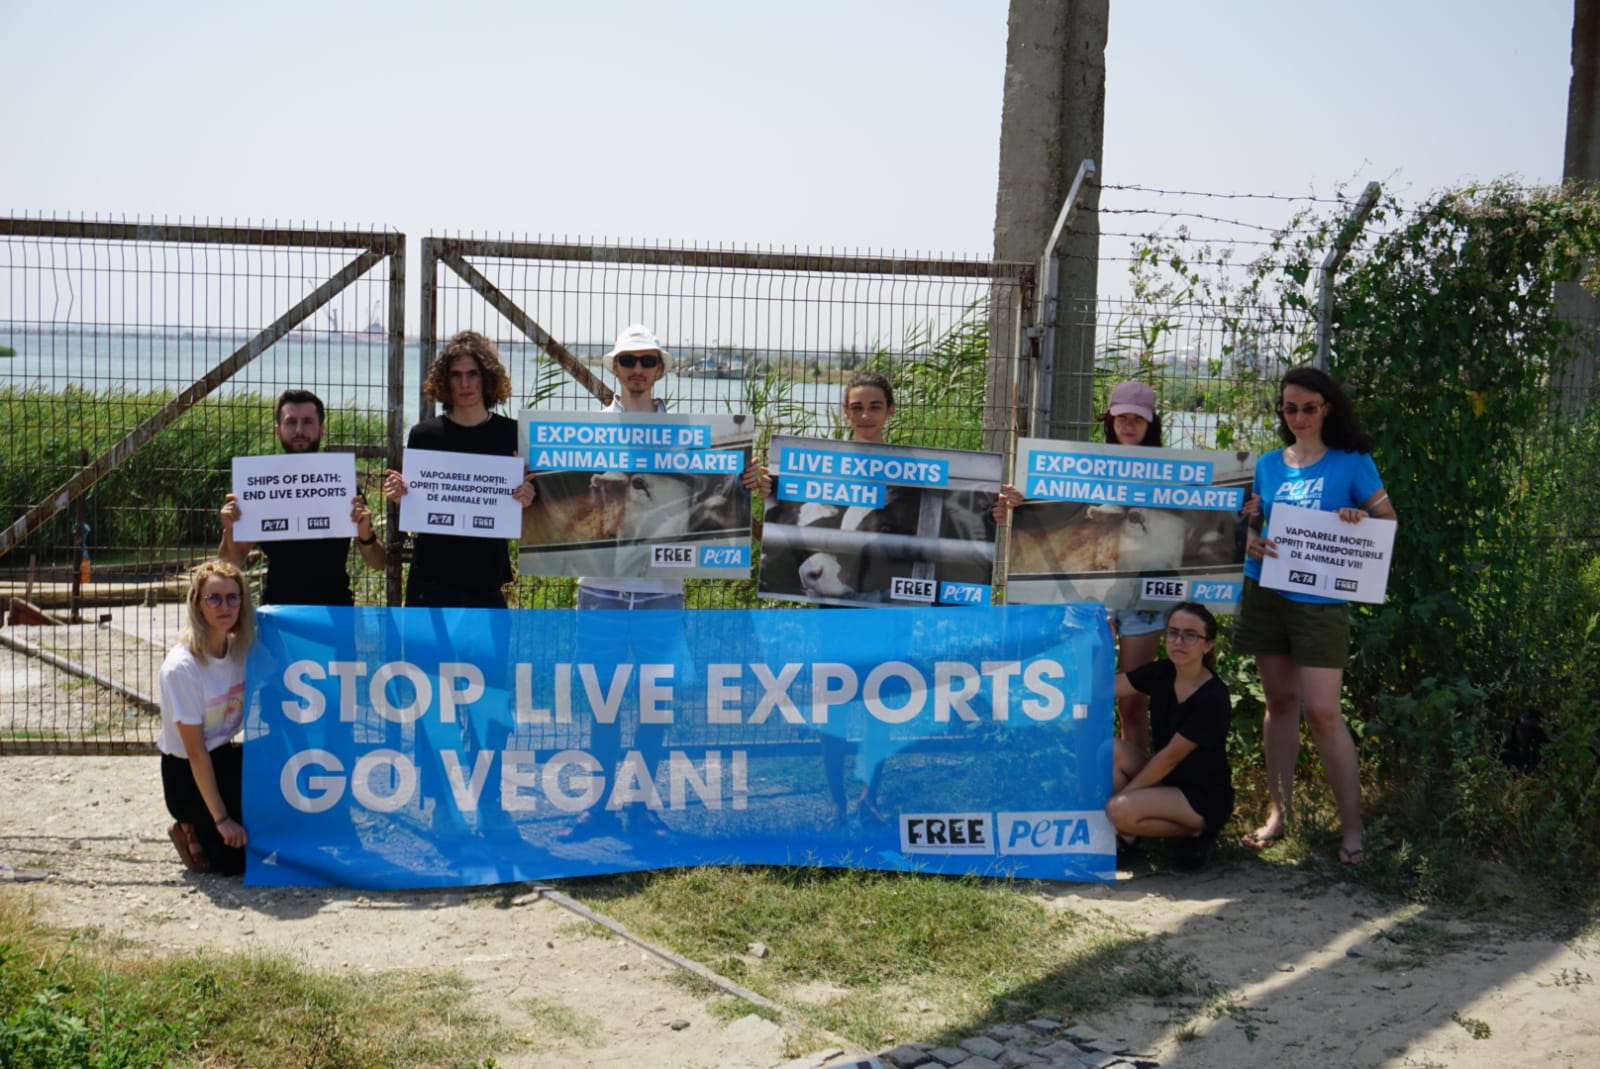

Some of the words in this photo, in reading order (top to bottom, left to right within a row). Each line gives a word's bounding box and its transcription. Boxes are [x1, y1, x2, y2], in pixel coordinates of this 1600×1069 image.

[537, 426, 672, 445] EXPORTURILE
[678, 429, 704, 446] DE
[536, 451, 629, 468] ANIMALE
[636, 458, 647, 468] =
[654, 454, 738, 470] MOARTE
[788, 452, 833, 474] LIVE
[840, 457, 942, 482] EXPORTS
[1036, 454, 1172, 480] EXPORTURILE
[1180, 464, 1206, 482] DE
[248, 475, 280, 486] SHIPS
[282, 474, 298, 484] OF
[302, 474, 342, 484] DEATH:
[420, 470, 471, 482] VAPOARELE
[243, 491, 266, 500] END
[270, 490, 292, 500] LIVE
[296, 488, 346, 498] EXPORTS
[428, 494, 438, 502] DE
[441, 495, 481, 504] ANIMALE
[786, 483, 798, 494] =
[805, 481, 878, 504] DEATH
[1033, 480, 1127, 502] ANIMALE
[1134, 492, 1146, 502] =
[1152, 488, 1238, 508] MOARTE
[309, 518, 328, 528] FREE
[1286, 526, 1338, 542] VAPOARELE
[655, 548, 692, 562] FREE
[1290, 550, 1302, 559] DE
[1304, 554, 1345, 566] ANIMALE
[1306, 542, 1384, 560] TRANSPORTURILE
[895, 580, 932, 596] FREE
[1145, 581, 1184, 596] FREE
[1336, 580, 1358, 590] FREE
[281, 660, 486, 724] STOP
[515, 663, 675, 724] LIVE
[706, 659, 1088, 724] EXPORTS.
[280, 748, 416, 813] GO
[442, 749, 748, 812] VEGAN!
[908, 819, 985, 844] FREE
